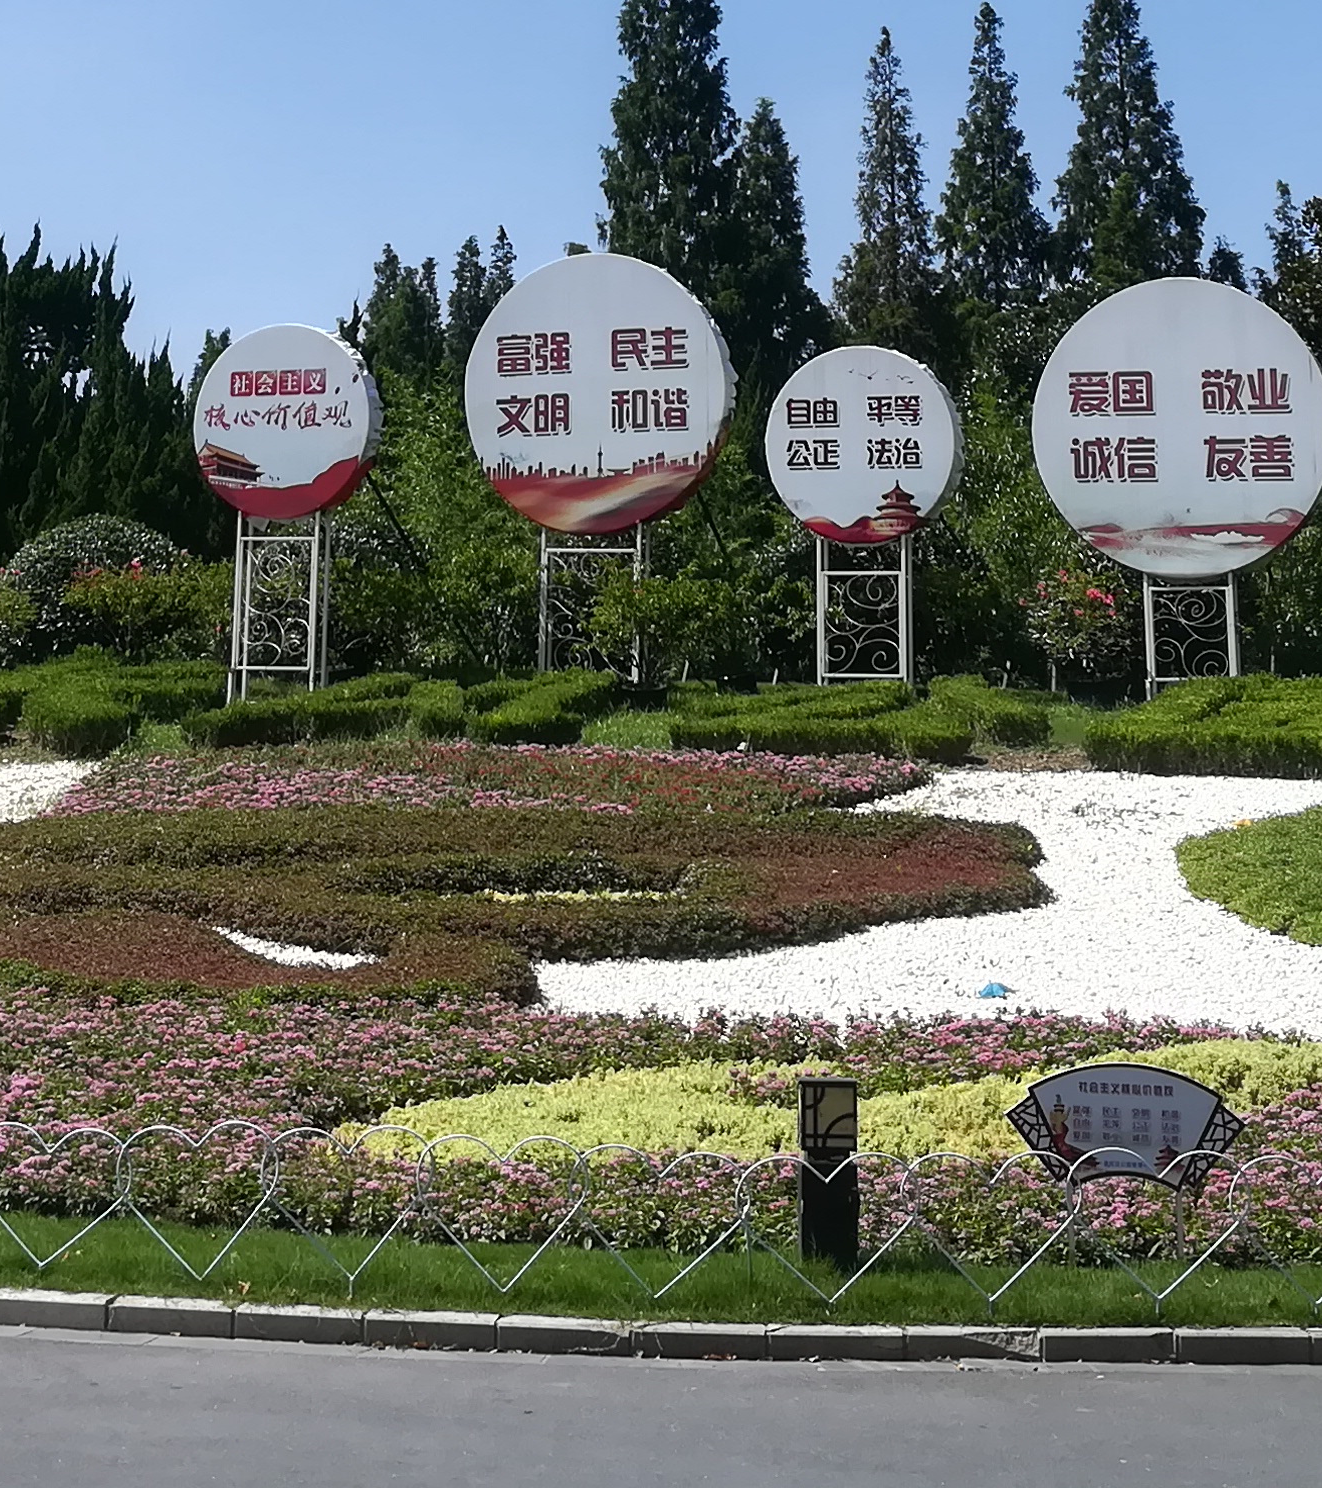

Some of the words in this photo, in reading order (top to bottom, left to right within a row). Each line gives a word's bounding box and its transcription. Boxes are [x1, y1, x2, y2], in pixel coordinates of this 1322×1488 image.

[496, 332, 572, 376] 富强
[611, 326, 689, 371] 民主
[233, 371, 323, 394] 社会主义
[1069, 370, 1156, 416] 爱国
[1201, 368, 1292, 415] 敬业
[204, 400, 352, 431] 核心价值观
[496, 393, 572, 437] 文明
[611, 388, 689, 433] 和谐
[786, 397, 840, 429] 自由
[867, 395, 922, 426] 平等
[786, 439, 840, 470] 公正
[867, 438, 922, 469] 法治
[1070, 437, 1158, 482] 诚信
[1204, 435, 1294, 482] 友善
